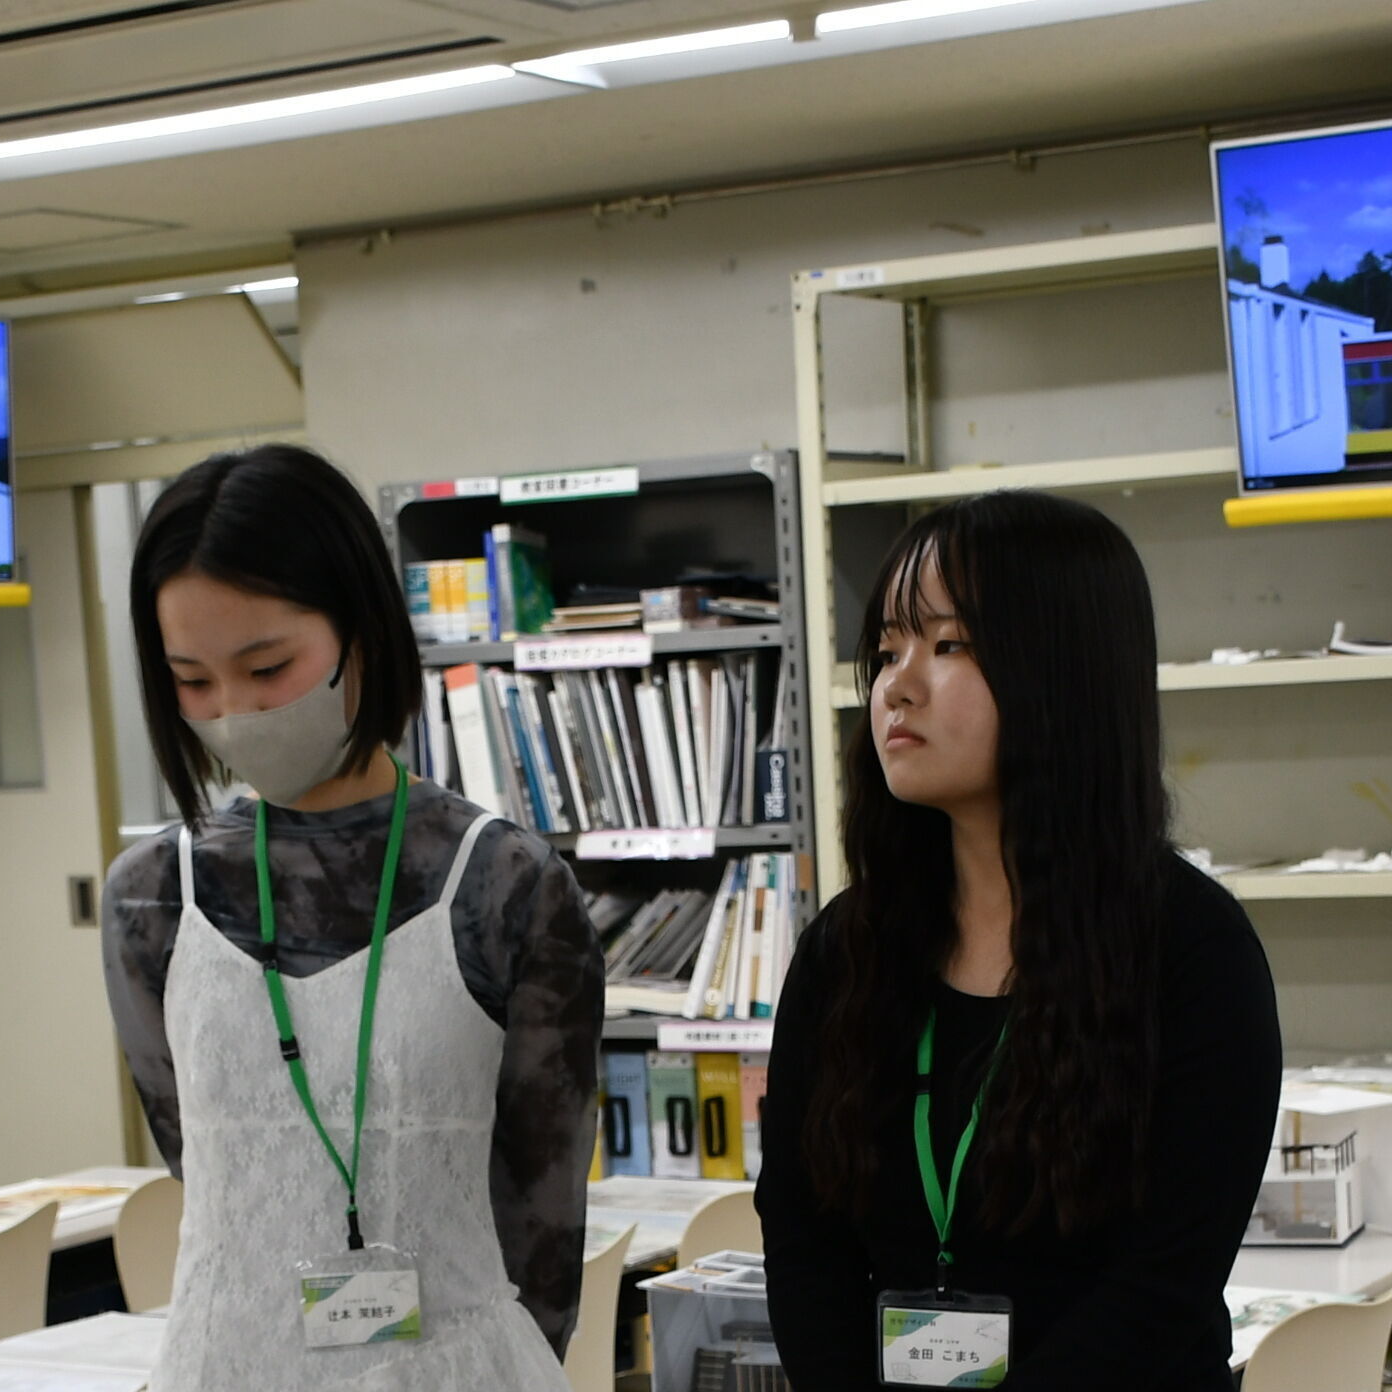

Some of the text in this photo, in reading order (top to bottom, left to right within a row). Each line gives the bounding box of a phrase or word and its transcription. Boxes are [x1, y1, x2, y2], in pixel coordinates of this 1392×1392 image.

[908, 1346, 981, 1364] 金田 こまち
